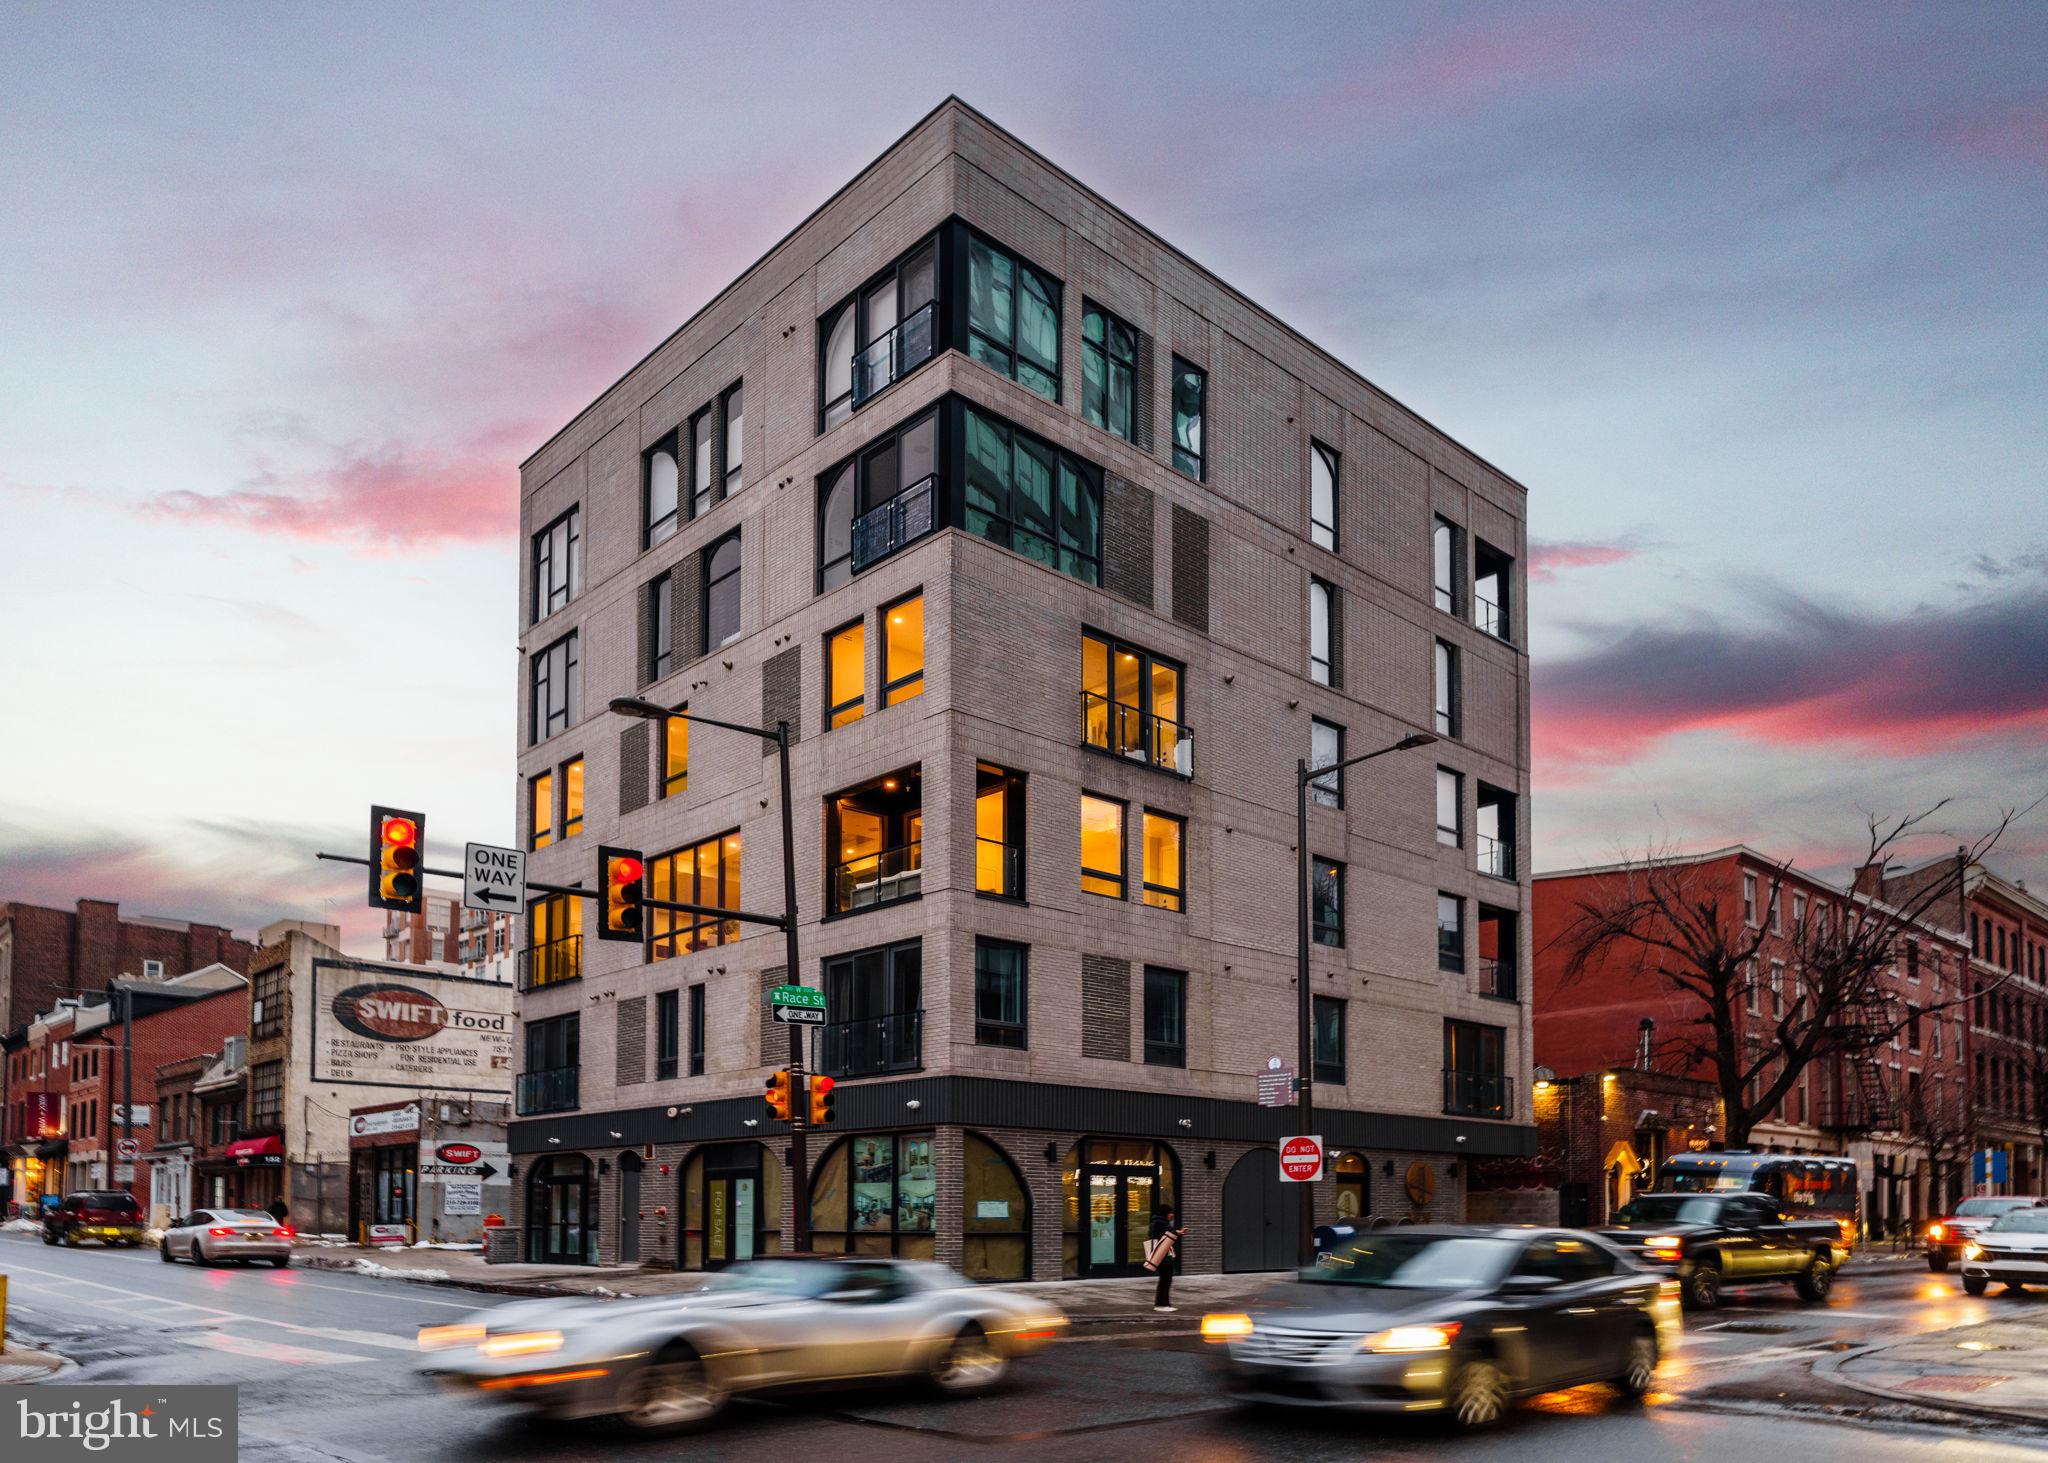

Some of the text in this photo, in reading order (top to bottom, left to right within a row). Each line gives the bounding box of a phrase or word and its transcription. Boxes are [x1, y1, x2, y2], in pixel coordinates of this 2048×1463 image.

[475, 849, 517, 869] ONE
[475, 867, 516, 886] WAY
[782, 991, 824, 1006] Race St
[359, 998, 443, 1025] SWIFT
[788, 1010, 802, 1019] ONE
[453, 1012, 505, 1030] food
[331, 1039, 385, 1051] RESTAURANTS
[331, 1049, 379, 1060] PIZZA SHOPS
[437, 1048, 479, 1057] APPLIANCES
[331, 1059, 352, 1068] BARS
[400, 1053, 415, 1062] FOR
[418, 1055, 462, 1066] RESIDENTIAL
[331, 1068, 353, 1078] DELIS
[395, 1063, 434, 1074] CATERERS
[446, 1149, 480, 1159] SWIFT
[1286, 1145, 1315, 1154] DO NOT
[421, 1165, 478, 1175] PARKING
[1288, 1165, 1313, 1173] ENTER
[713, 1218, 722, 1249] SALE
